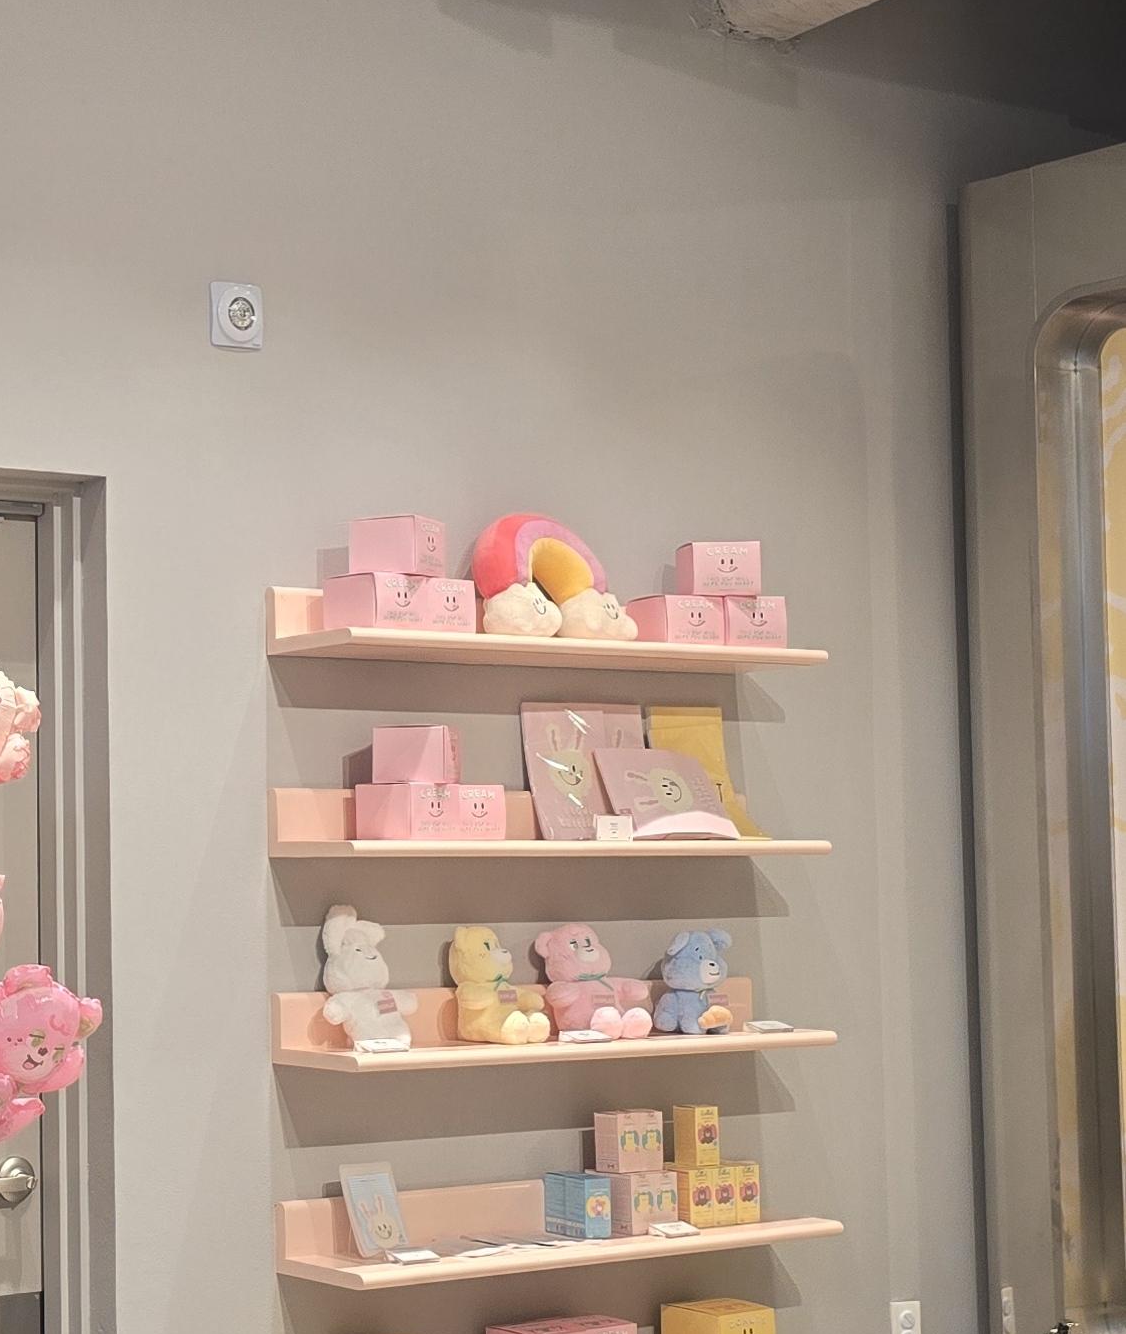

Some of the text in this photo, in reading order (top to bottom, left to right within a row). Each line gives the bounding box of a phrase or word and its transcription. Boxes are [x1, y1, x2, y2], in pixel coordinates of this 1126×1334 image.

[706, 546, 748, 556] CREAM
[385, 578, 418, 590] CREAM
[435, 582, 467, 594] CREAM
[678, 599, 714, 610] CREAM
[740, 600, 776, 610] CREAM
[420, 789, 451, 800] CREAM
[462, 788, 495, 800] CREAM
